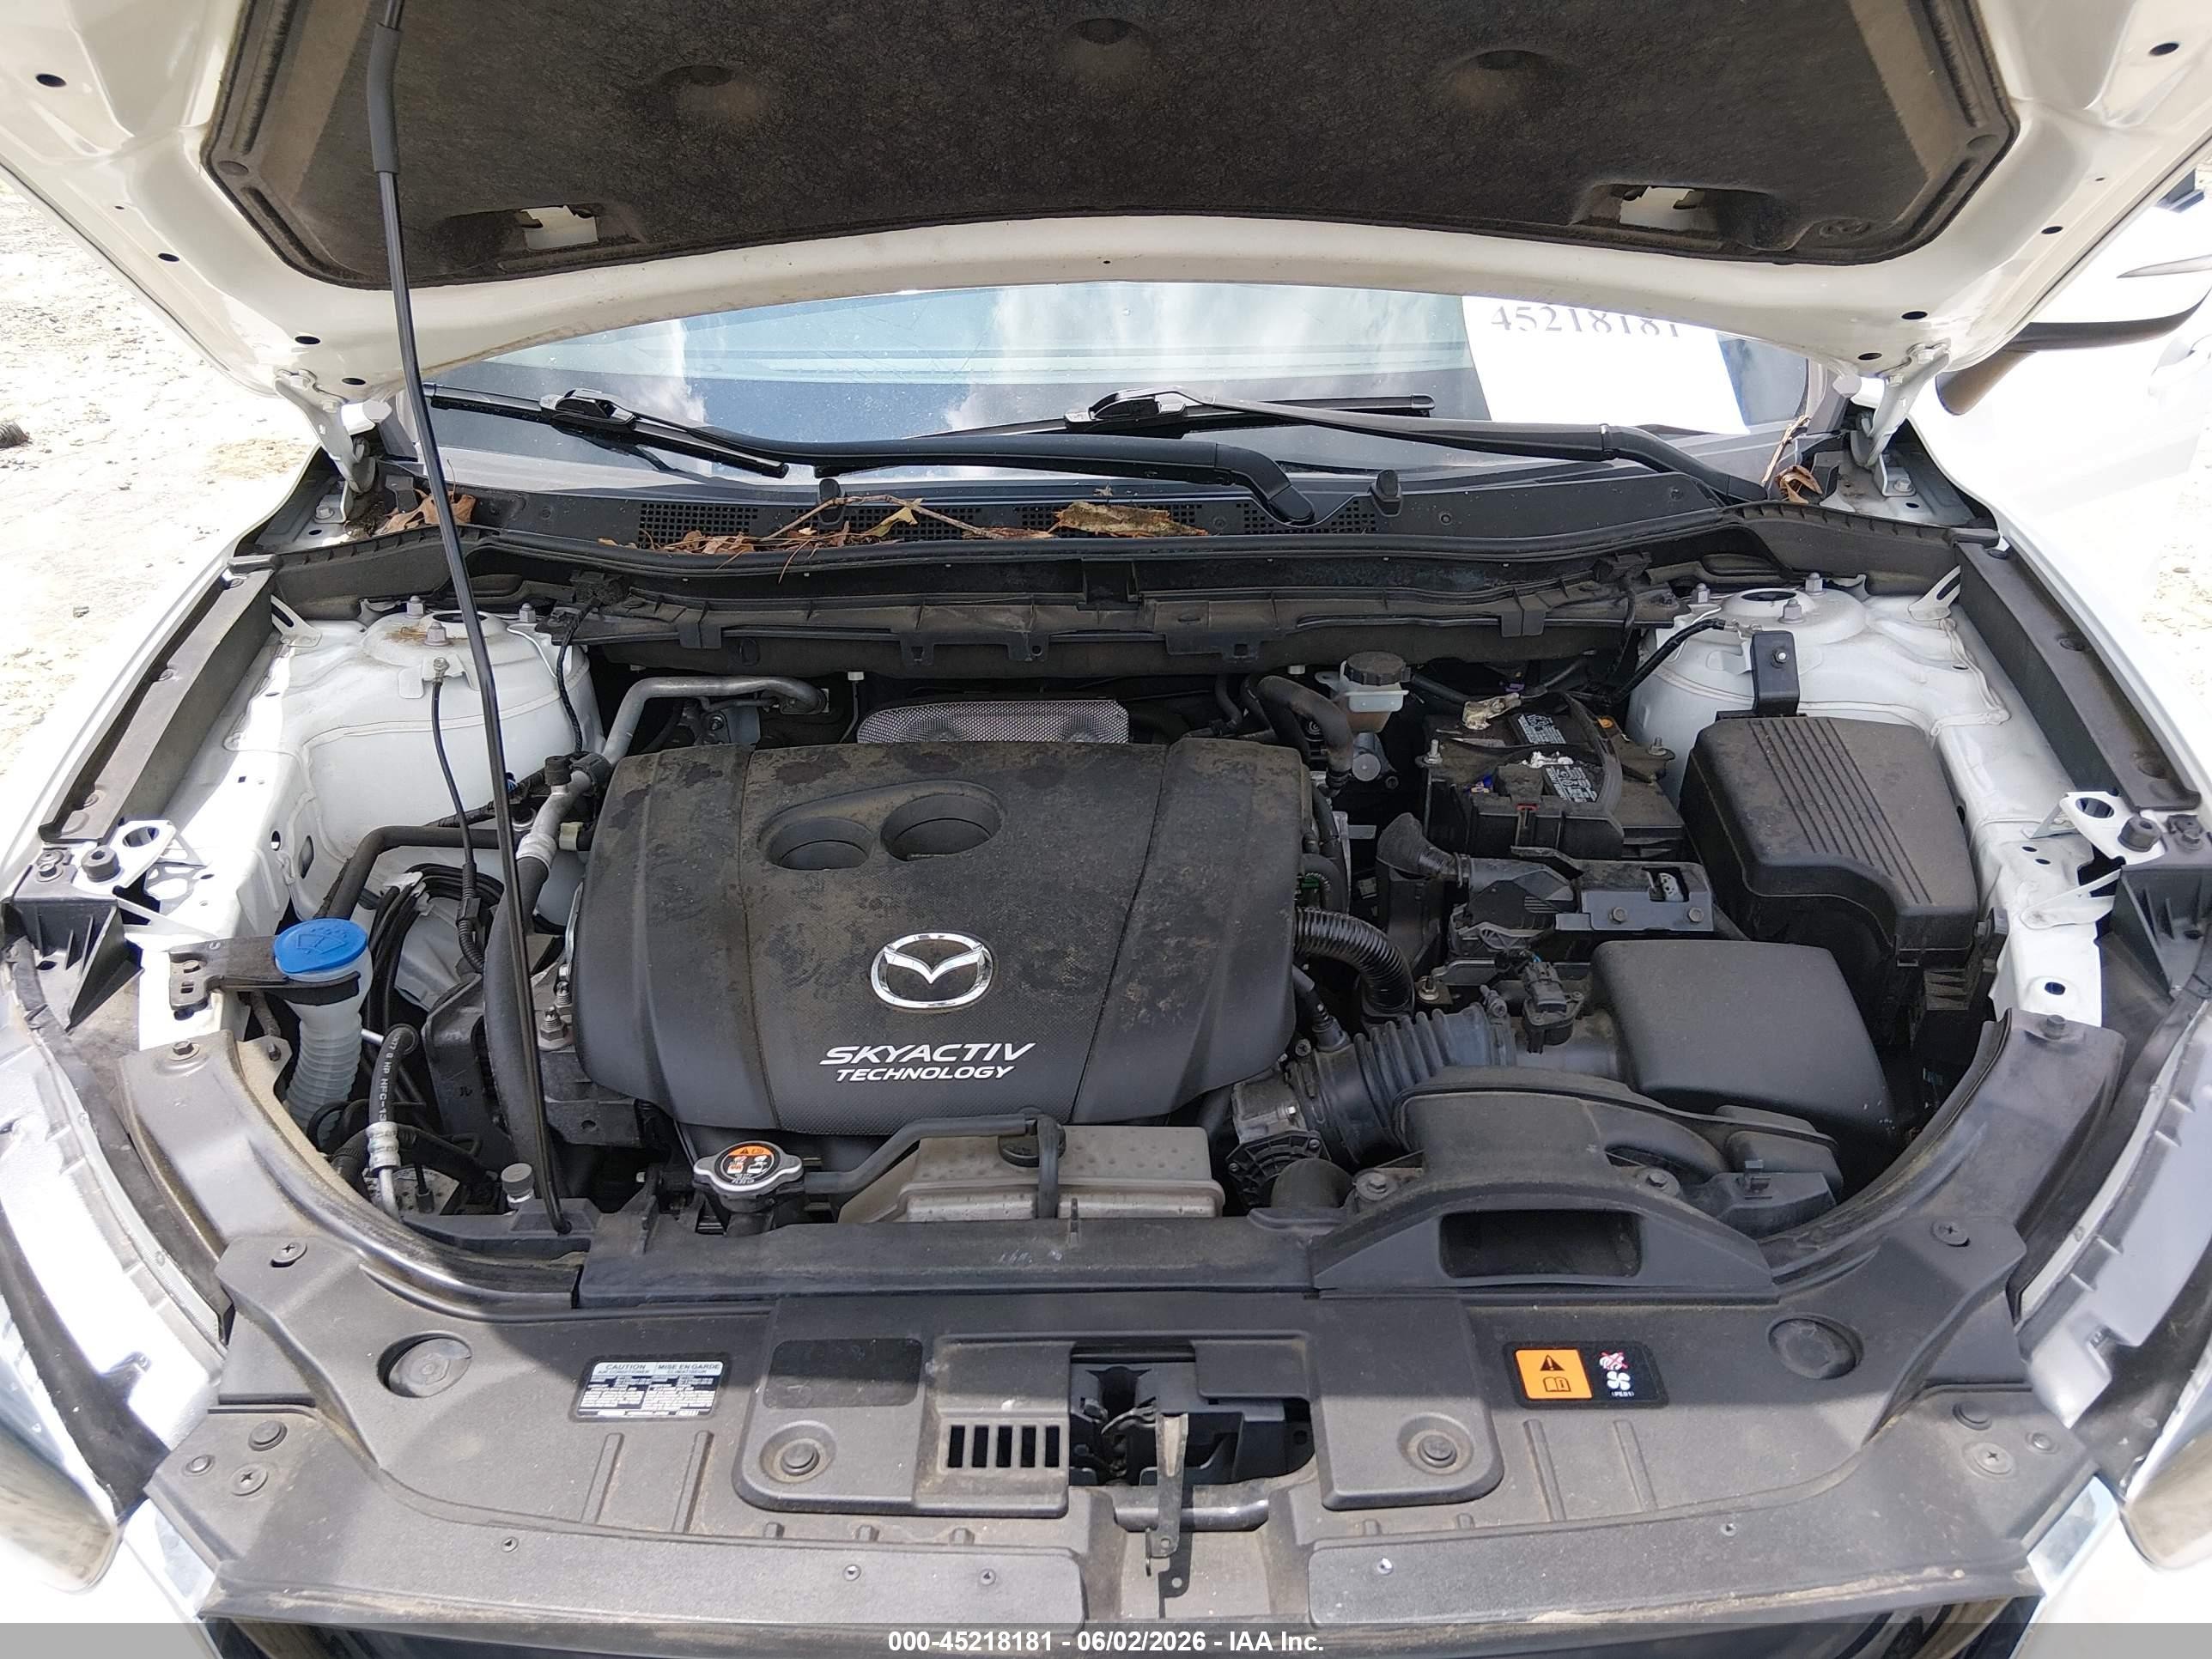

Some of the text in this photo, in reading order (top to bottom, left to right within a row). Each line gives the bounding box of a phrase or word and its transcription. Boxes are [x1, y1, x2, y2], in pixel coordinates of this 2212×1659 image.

[1491, 306, 1679, 337] 45218181
[818, 1042, 1036, 1066] SKYACTIV
[383, 1061, 392, 1074] HP
[836, 1066, 1017, 1082] TECHNOLOGY
